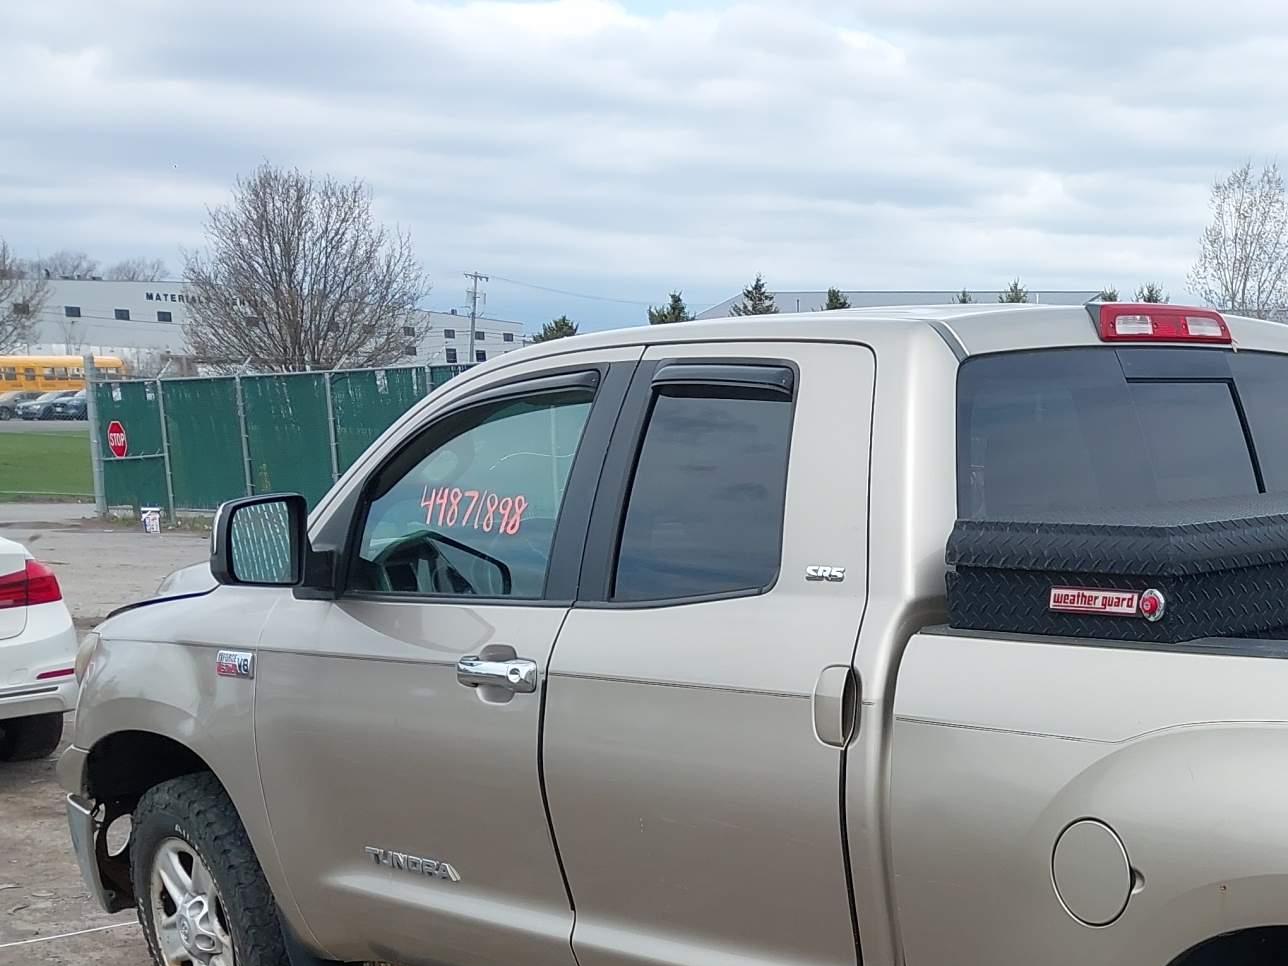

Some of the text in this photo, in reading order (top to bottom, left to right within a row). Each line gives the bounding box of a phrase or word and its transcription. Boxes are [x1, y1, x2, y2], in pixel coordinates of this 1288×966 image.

[109, 432, 125, 447] STOP
[420, 485, 528, 535] 44871898
[805, 565, 846, 582] SR5
[1053, 592, 1134, 609] weather guard
[236, 656, 249, 672] V8
[364, 846, 461, 881] TUNDRA
